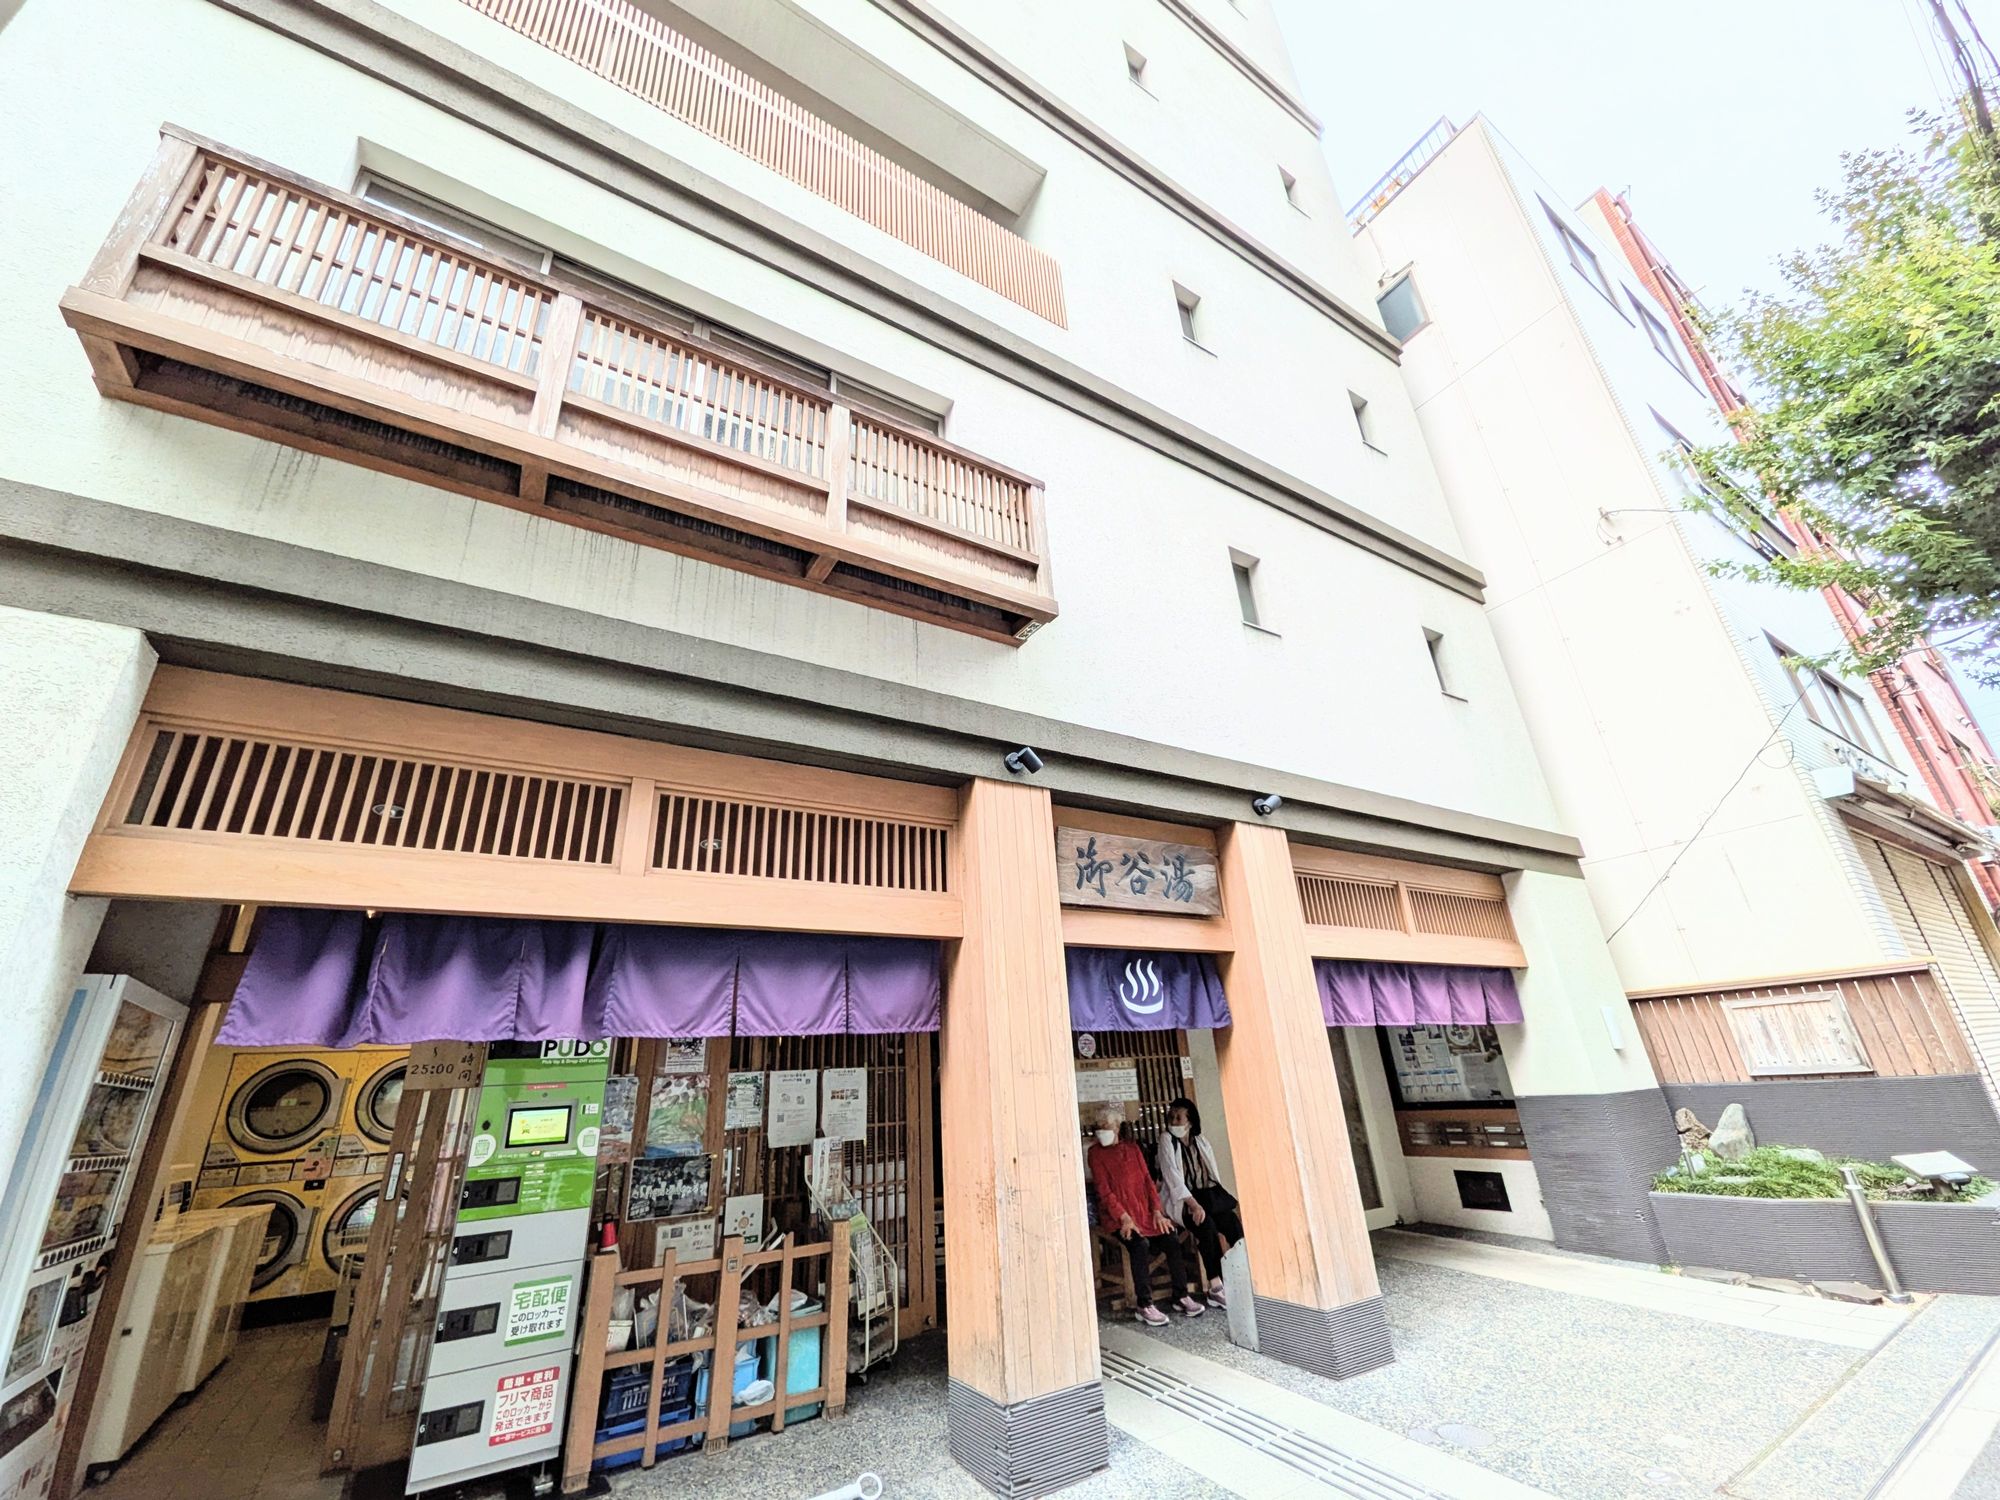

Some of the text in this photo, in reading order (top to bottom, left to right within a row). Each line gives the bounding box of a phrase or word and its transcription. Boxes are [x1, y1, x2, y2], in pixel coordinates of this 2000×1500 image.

[1076, 836, 1196, 903] 御谷湯
[543, 1039, 608, 1057] PUDO
[410, 1063, 454, 1075] 25:00
[457, 1042, 475, 1082] 時間
[463, 1191, 469, 1199] 3
[514, 1285, 568, 1310] 宅配便
[510, 1306, 566, 1324] このロッカーで
[510, 1318, 563, 1337] 受け取れます
[503, 1369, 554, 1389] 簡単・便利
[498, 1384, 554, 1408] フリマ商品
[496, 1399, 552, 1420] このロッカーから
[419, 1425, 426, 1433] 6
[494, 1410, 550, 1432] 発送できます
